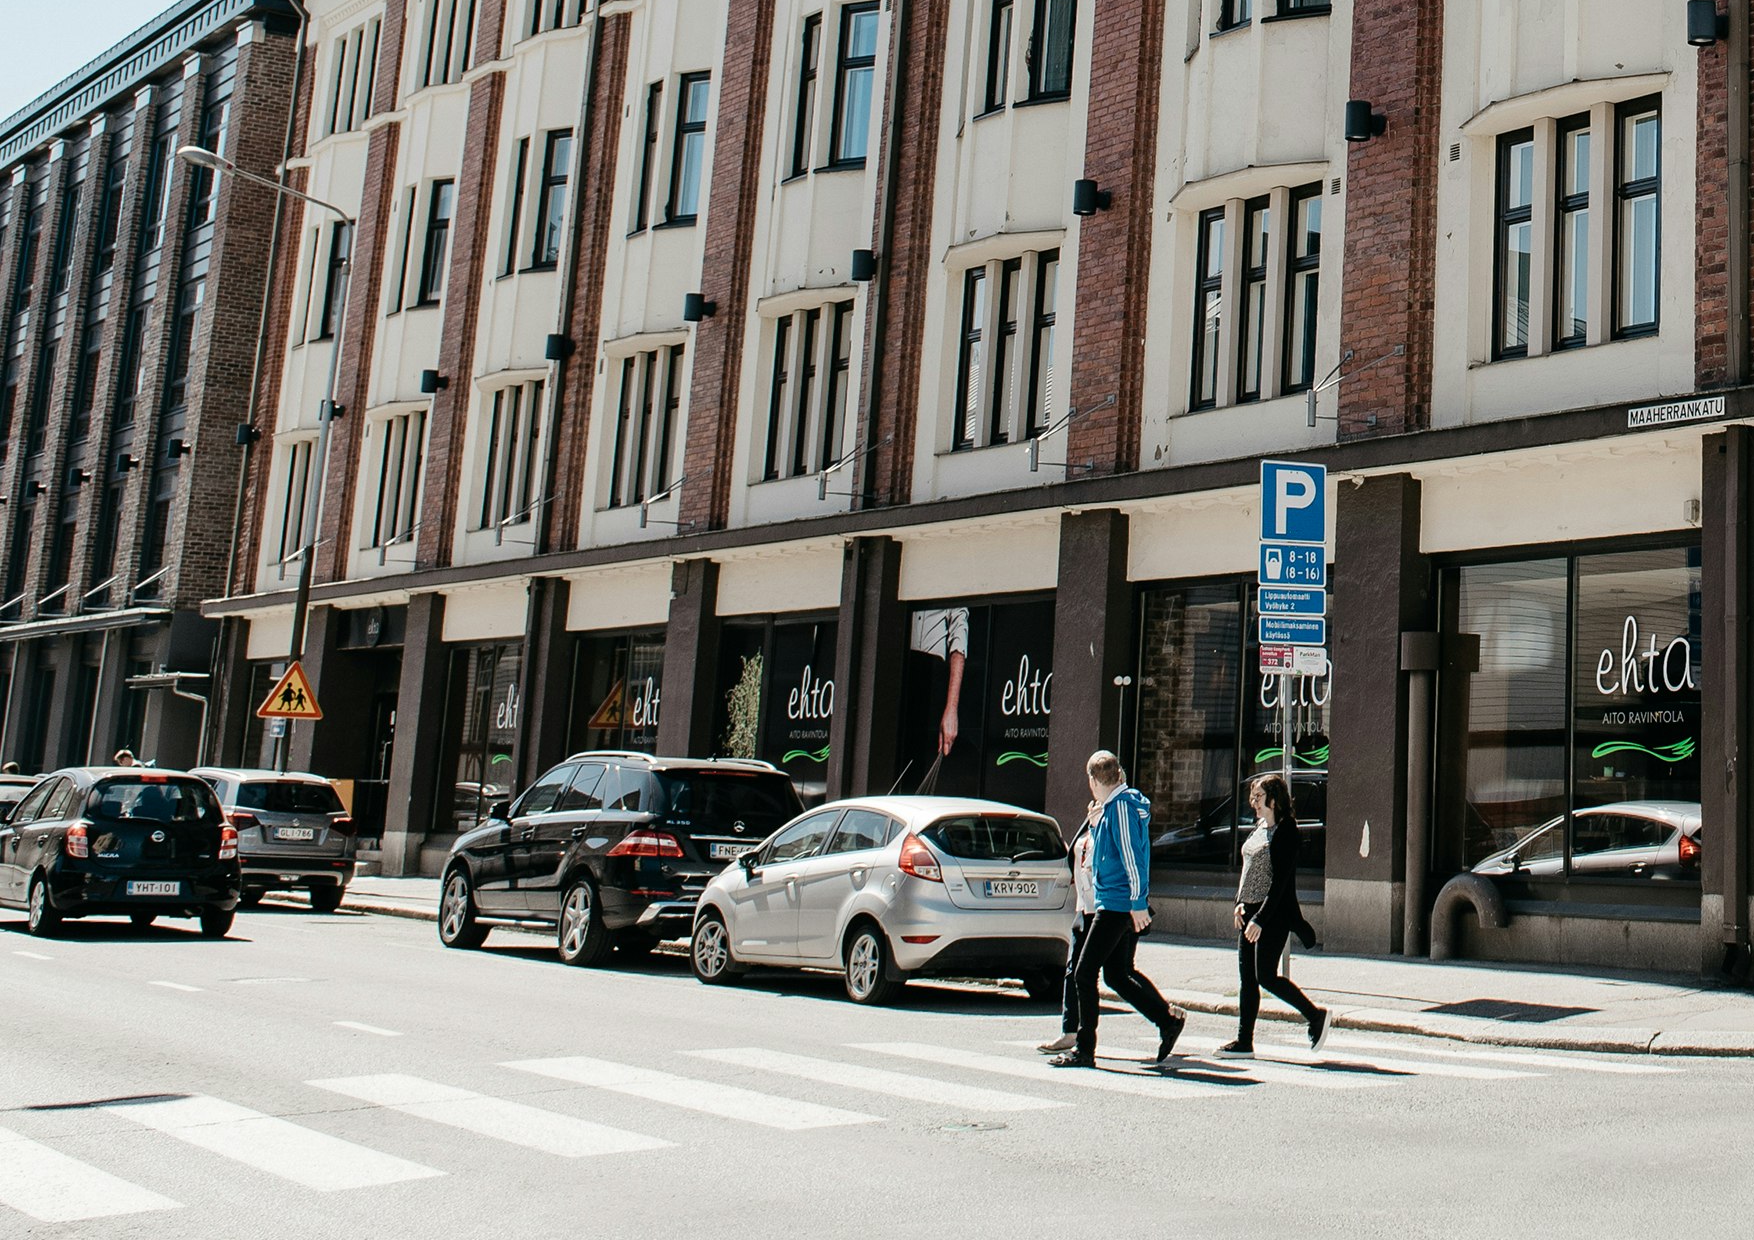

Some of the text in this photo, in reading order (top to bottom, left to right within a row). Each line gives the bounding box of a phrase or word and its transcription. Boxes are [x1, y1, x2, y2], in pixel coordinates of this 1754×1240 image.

[1630, 399, 1723, 425] MAAHERRANKATU
[1276, 469, 1316, 534] P
[1265, 592, 1310, 600] Lippuautomaatti
[1265, 602, 1288, 610] Vyöhyke
[1266, 621, 1319, 630] Mobiilimaksaminen
[1597, 615, 1694, 694] ehta
[788, 665, 835, 719] ehta
[497, 684, 519, 729] eht
[634, 676, 660, 727] eht
[1602, 711, 1684, 724] AITO RAVINTOLA
[1005, 727, 1049, 738] AITO RAVINTOL
[281, 829, 312, 838] GLI-786
[994, 882, 1037, 894] KRV-902
